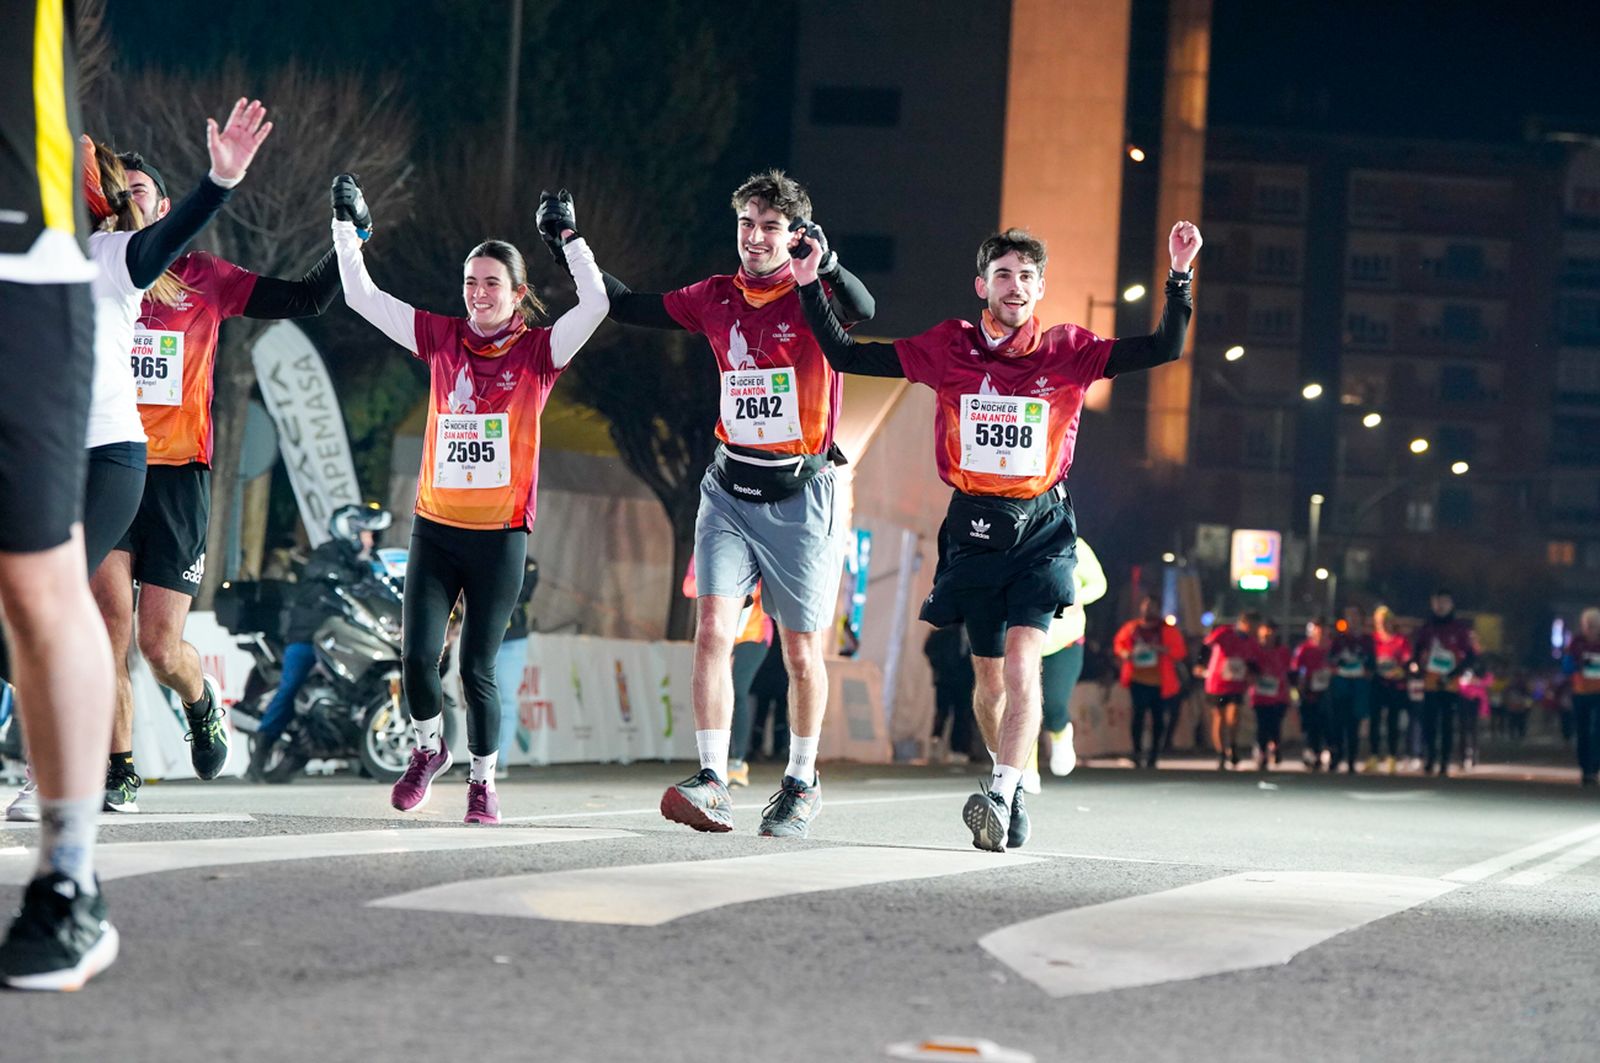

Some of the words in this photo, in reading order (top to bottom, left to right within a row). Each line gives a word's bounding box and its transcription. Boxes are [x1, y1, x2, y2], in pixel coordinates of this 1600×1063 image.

[131, 346, 153, 355] NTÓN
[131, 356, 168, 379] 865
[756, 378, 765, 386] DE
[742, 387, 766, 396] ANTÓN
[736, 396, 783, 419] 2642
[981, 404, 1006, 412] NOCHE
[1008, 405, 1018, 413] DE
[970, 412, 988, 421] SAN
[989, 413, 1017, 423] ANTÓN
[457, 431, 478, 440] ANTÓN
[976, 423, 1033, 448] 5398
[447, 441, 495, 463] 2595
[733, 483, 762, 496] Reebok
[970, 531, 990, 540] adidas
